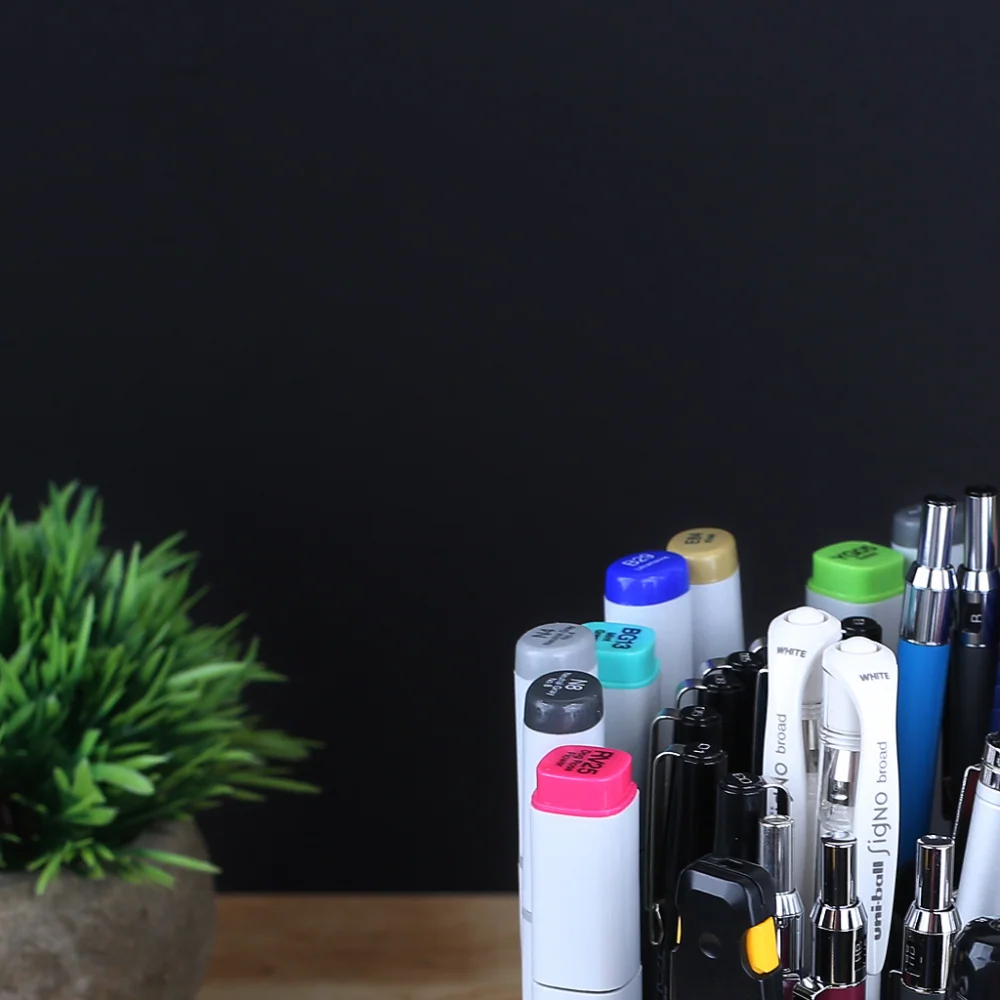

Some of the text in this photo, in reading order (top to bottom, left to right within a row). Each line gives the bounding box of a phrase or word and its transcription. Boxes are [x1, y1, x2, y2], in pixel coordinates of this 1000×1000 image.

[611, 627, 643, 650] BG13
[776, 646, 807, 658] WHITE
[564, 679, 588, 691] N8
[859, 672, 891, 682] WHITE
[775, 713, 787, 754] broad
[576, 750, 615, 775] RV25
[876, 741, 888, 784] broad
